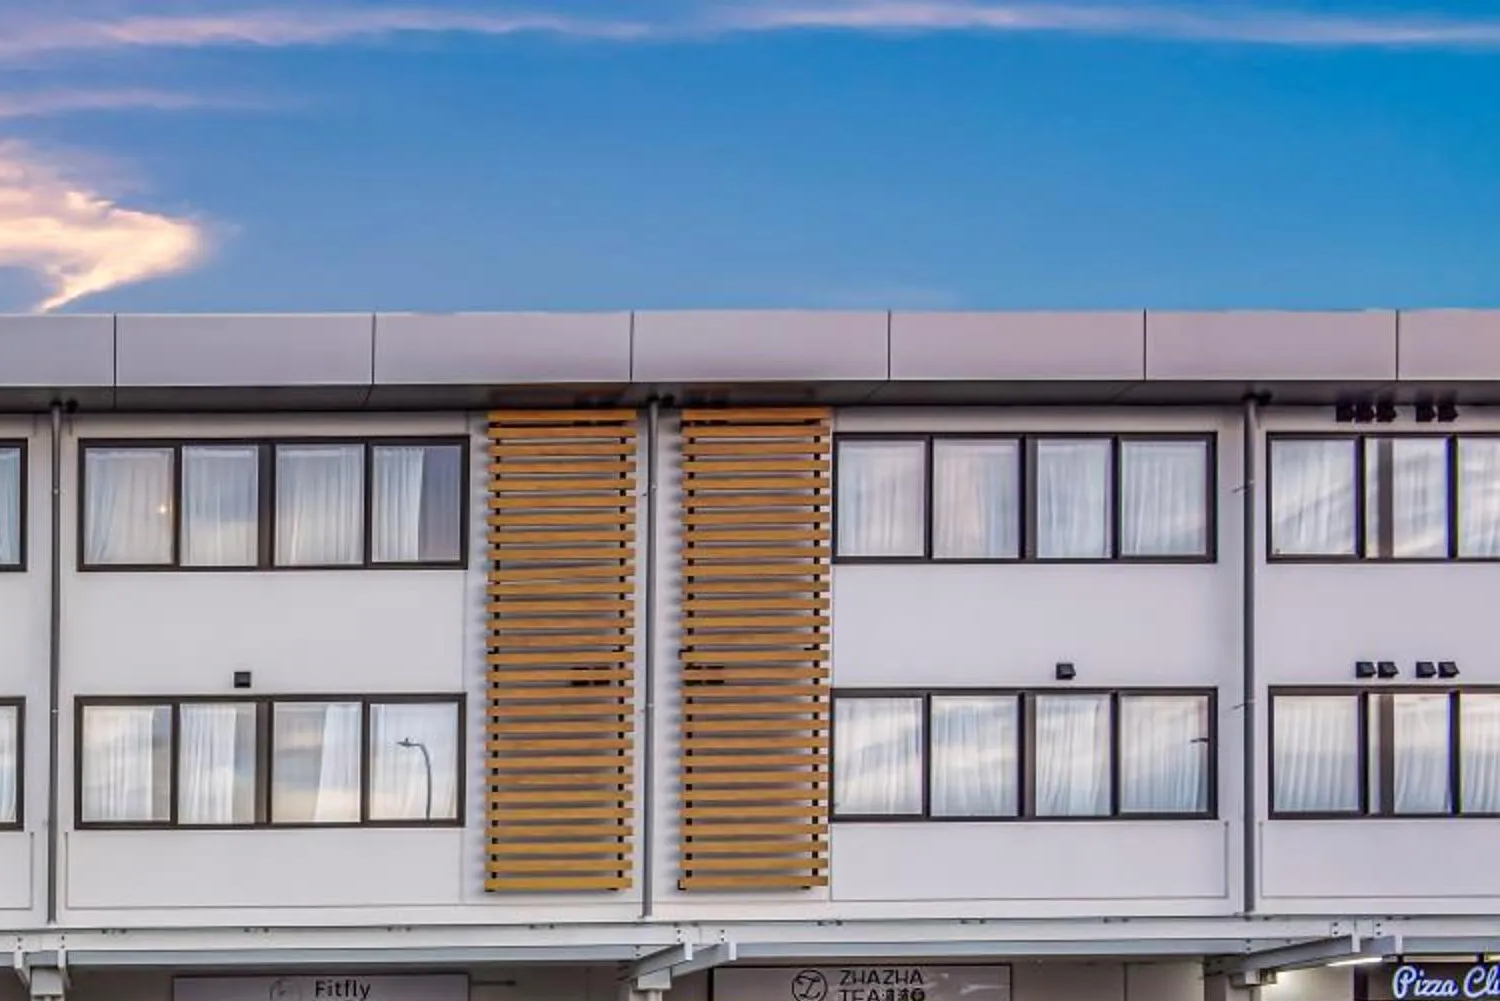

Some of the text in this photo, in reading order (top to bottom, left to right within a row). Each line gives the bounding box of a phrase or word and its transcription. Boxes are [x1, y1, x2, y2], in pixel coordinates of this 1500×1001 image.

[839, 969, 924, 985] ZHAZHA
[1393, 964, 1459, 999] Pizza
[315, 979, 371, 1000] Fitfly
